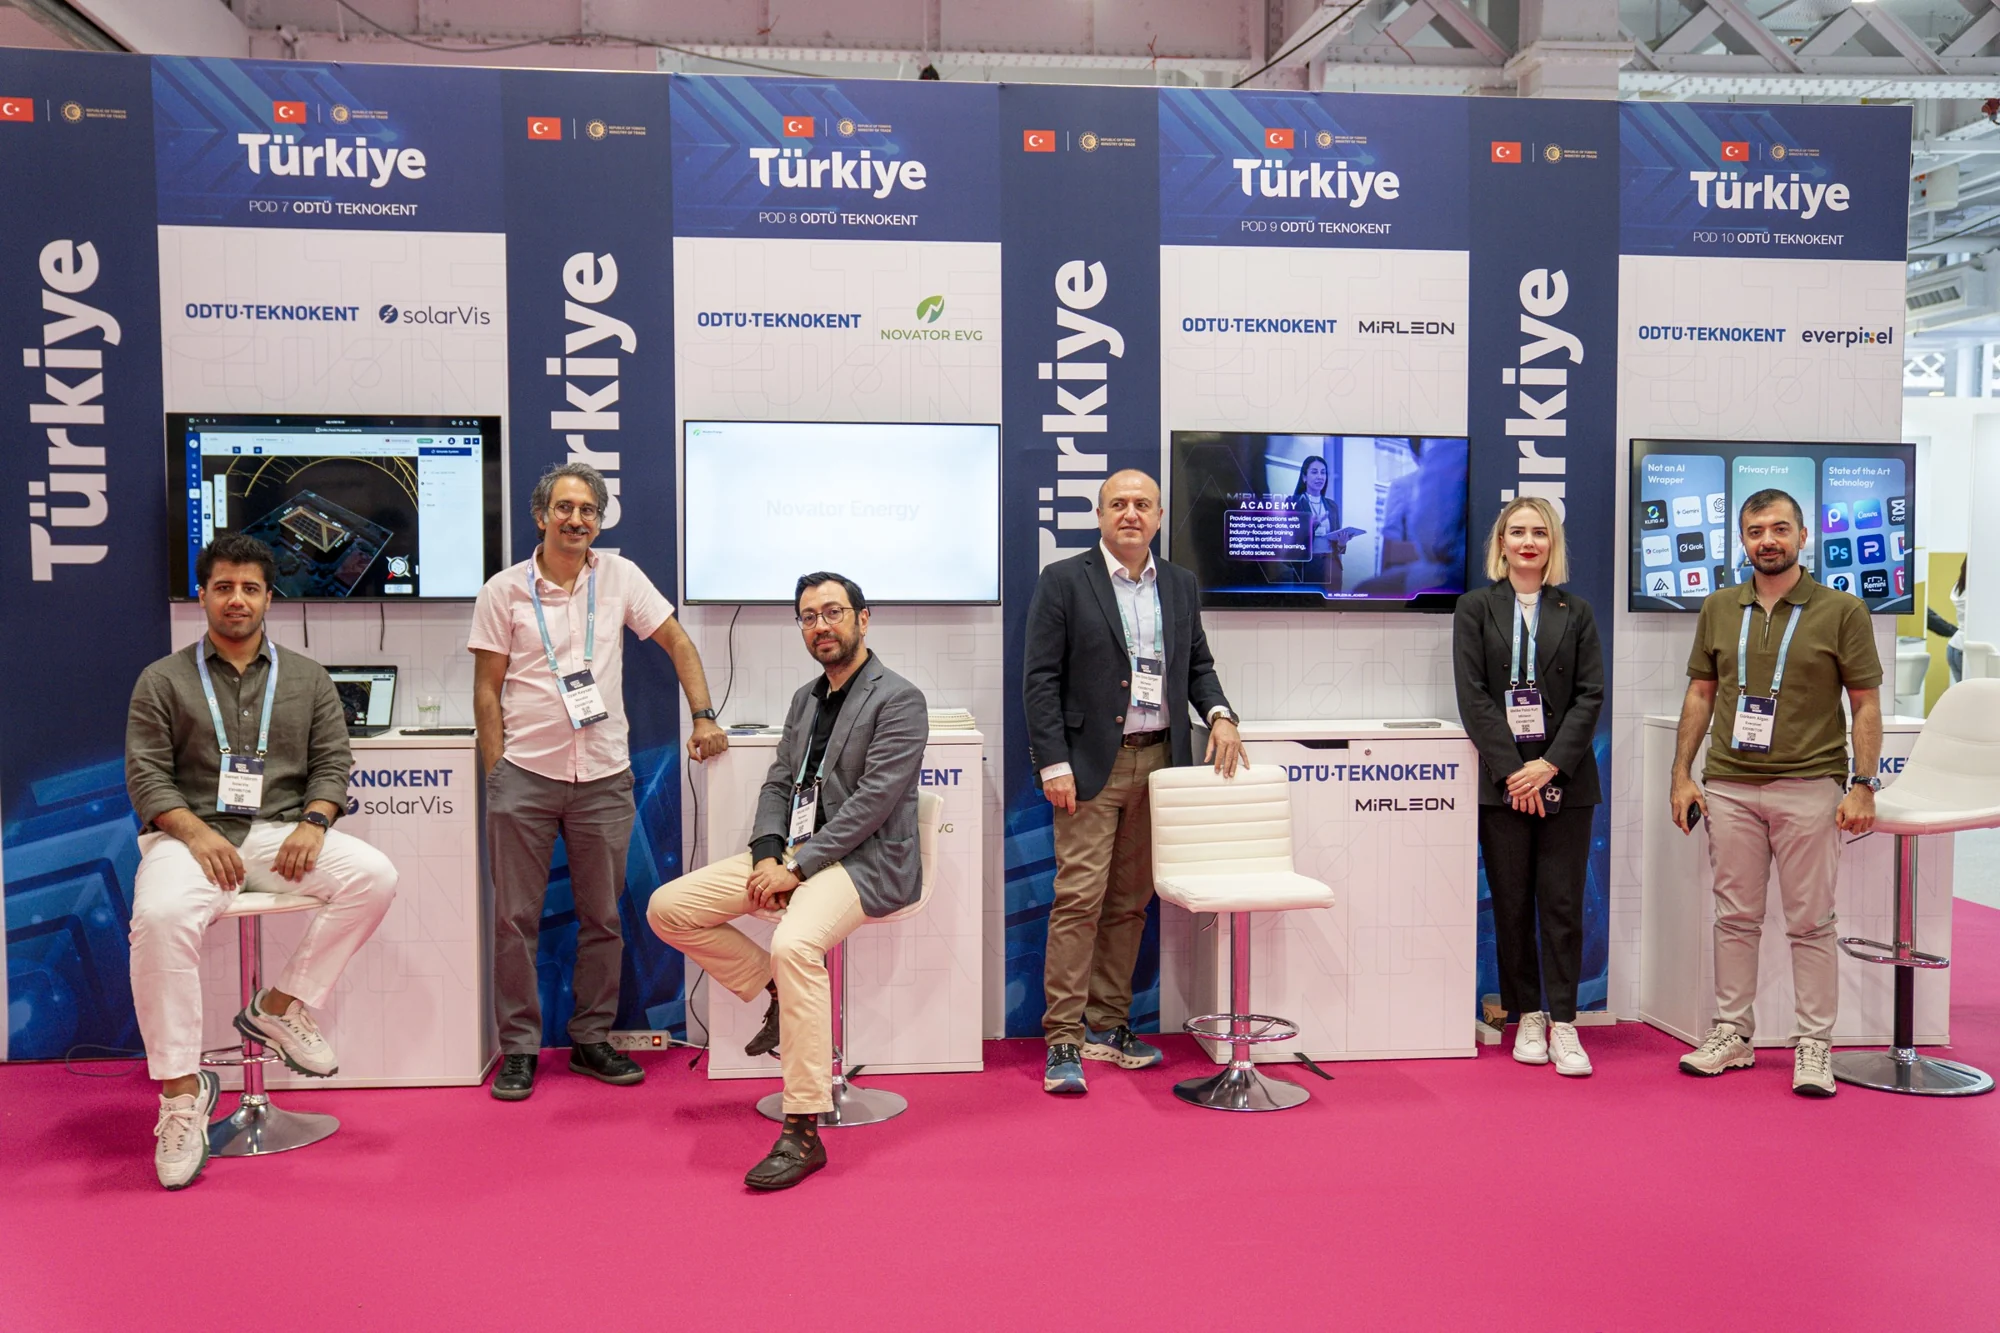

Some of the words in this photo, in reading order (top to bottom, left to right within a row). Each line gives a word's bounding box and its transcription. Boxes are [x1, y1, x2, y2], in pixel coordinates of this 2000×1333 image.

[238, 133, 426, 187] Türkiye
[750, 148, 926, 198] Türkiye
[1233, 158, 1400, 208] Türkiye
[1690, 171, 1850, 219] Türkiye
[249, 200, 278, 213] POD
[282, 201, 289, 214] 7
[293, 199, 332, 214] ODTÜ
[335, 202, 418, 216] TEKNOKENT
[759, 212, 785, 224] POD
[789, 212, 797, 224] 8
[800, 211, 837, 224] ODTÜ
[840, 213, 918, 226] TEKNOKENT
[1241, 221, 1266, 231] POD
[1270, 221, 1277, 232] 9
[1280, 221, 1315, 233] ODTÜ
[1318, 222, 1391, 234] TEKNOKENT
[1693, 232, 1718, 242] POD
[1722, 232, 1734, 243] 10
[1737, 231, 1770, 244] ODTÜ
[1773, 233, 1844, 245] TEKNOKENT
[403, 304, 491, 326] solarVis
[881, 329, 950, 341] NOVATOR
[955, 330, 983, 341] EVG
[1802, 326, 1892, 348] everpixel
[23, 239, 122, 581] Türkiye
[546, 252, 637, 555] rkiye
[1648, 464, 1661, 472] Not
[1739, 465, 1767, 475] Privacy
[1770, 466, 1788, 474] First
[1829, 467, 1847, 475] State
[1850, 467, 1860, 475] of
[1862, 467, 1875, 475] the
[1877, 468, 1890, 476] Art
[1648, 476, 1684, 486] Wrapper
[1829, 478, 1874, 489] Technology
[766, 500, 844, 517] Novator
[851, 500, 920, 521] Energy
[1240, 501, 1297, 510] ACADEMY
[1829, 546, 1848, 560] Ps
[1864, 580, 1886, 589] Remini
[364, 796, 453, 815] solarVis
[938, 823, 954, 833] VG
